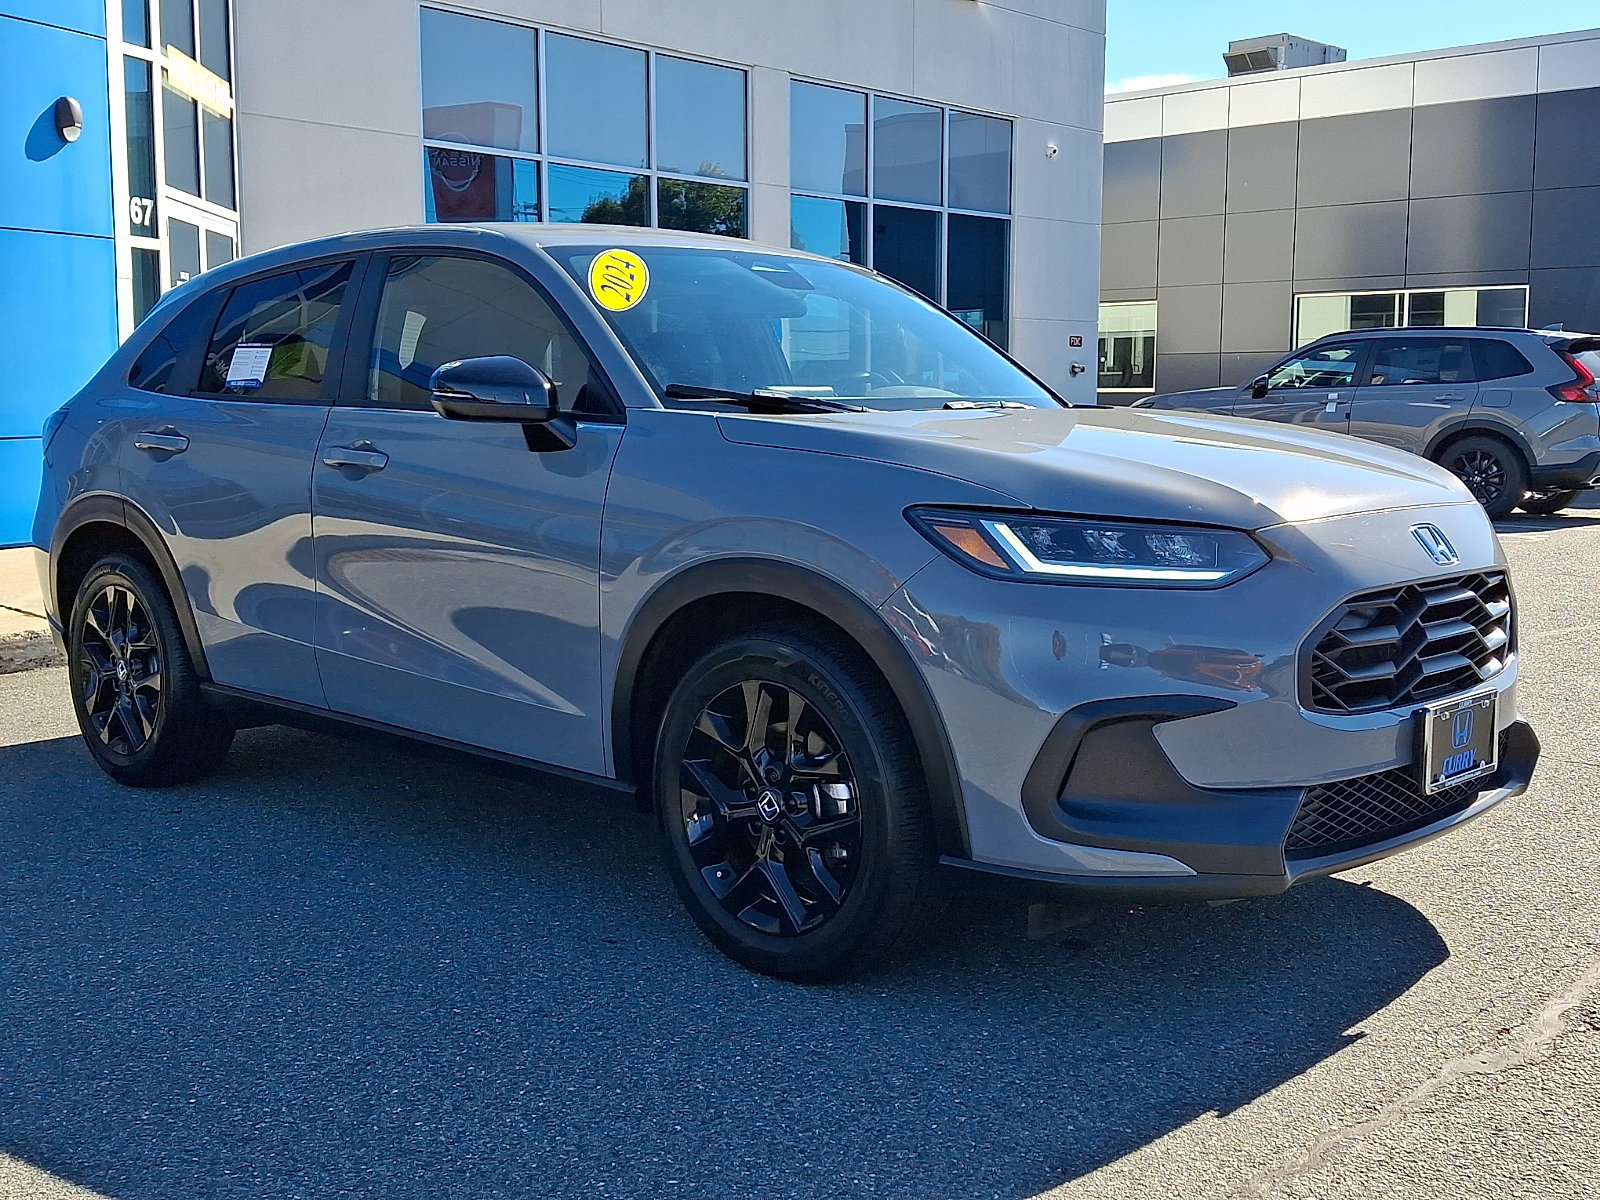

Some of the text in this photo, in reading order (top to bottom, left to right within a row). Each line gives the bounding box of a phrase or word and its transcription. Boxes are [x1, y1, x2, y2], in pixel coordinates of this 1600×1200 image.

[130, 196, 154, 227] 67
[600, 254, 637, 303] 2024
[1443, 748, 1477, 776] CURRY
